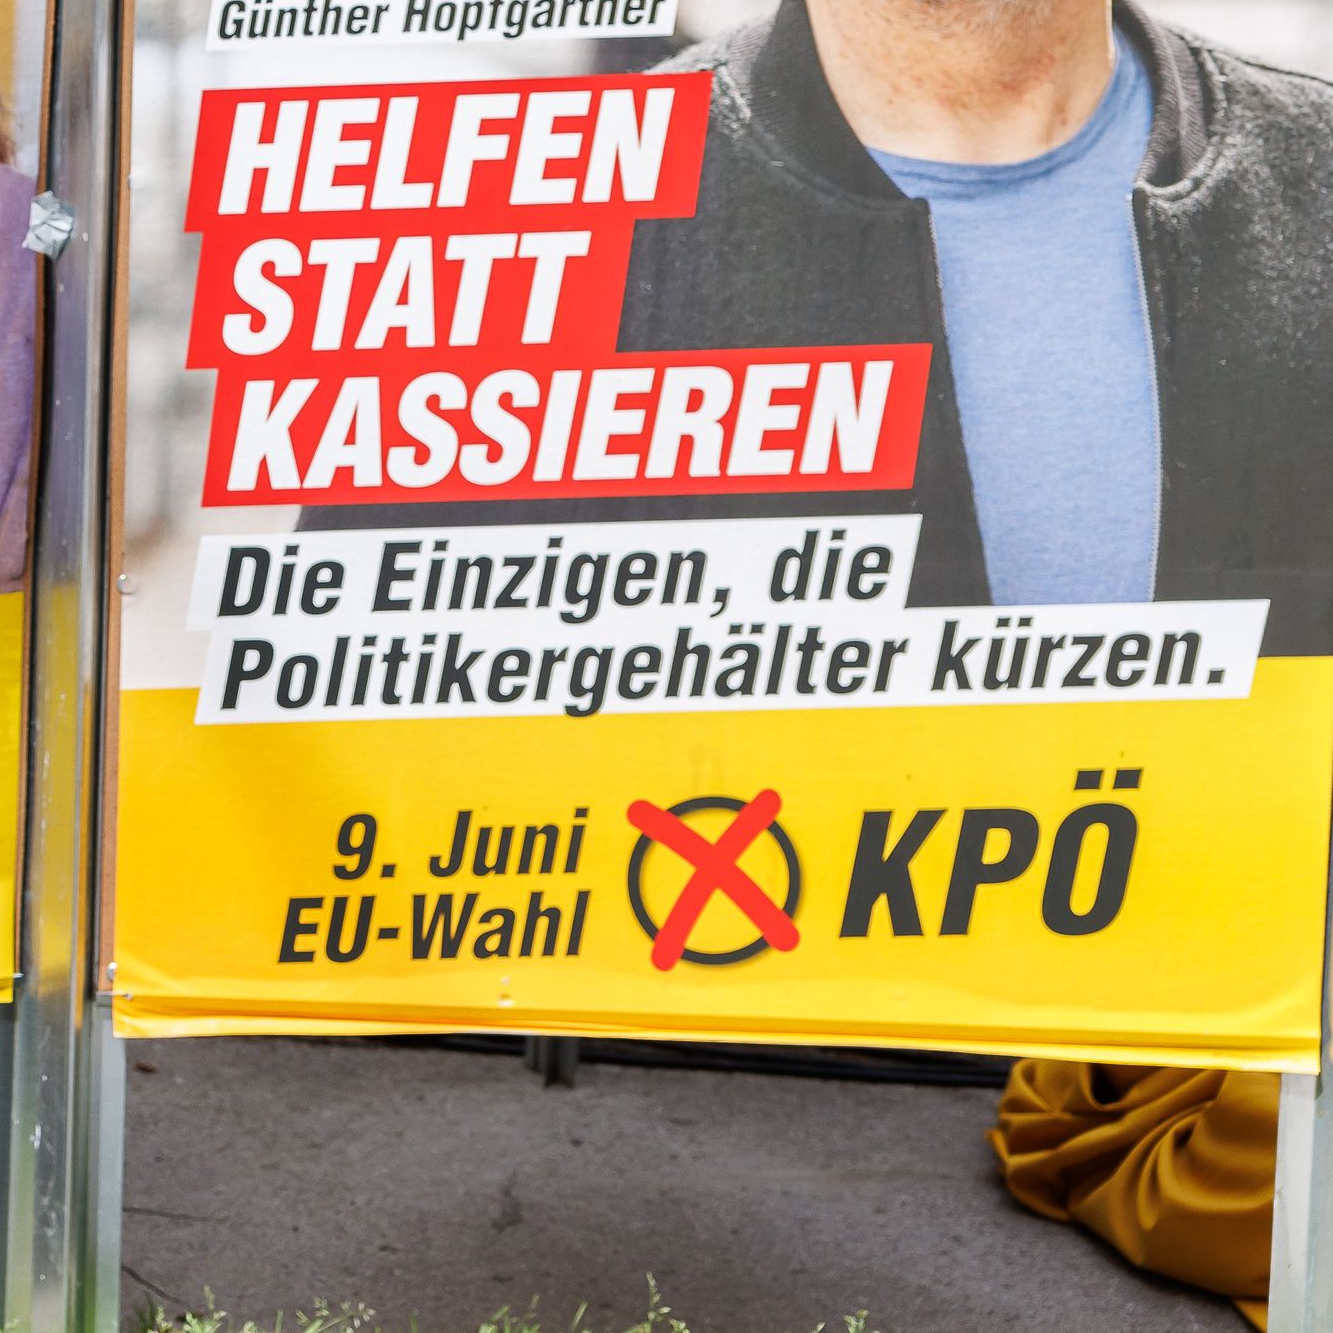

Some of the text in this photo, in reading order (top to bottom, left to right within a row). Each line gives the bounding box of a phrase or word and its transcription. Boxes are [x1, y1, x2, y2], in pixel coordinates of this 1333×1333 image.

[219, 89, 674, 214] HELFEN
[223, 232, 590, 354] STATT
[228, 361, 892, 490] KASSIEREN
[219, 530, 890, 623] Die Einzigen, die
[223, 618, 1222, 717] Politikergehälter kürzen.
[334, 809, 587, 880] 9. Juni
[840, 770, 1141, 937] KPÖ
[279, 891, 589, 962] EU-Wahl
